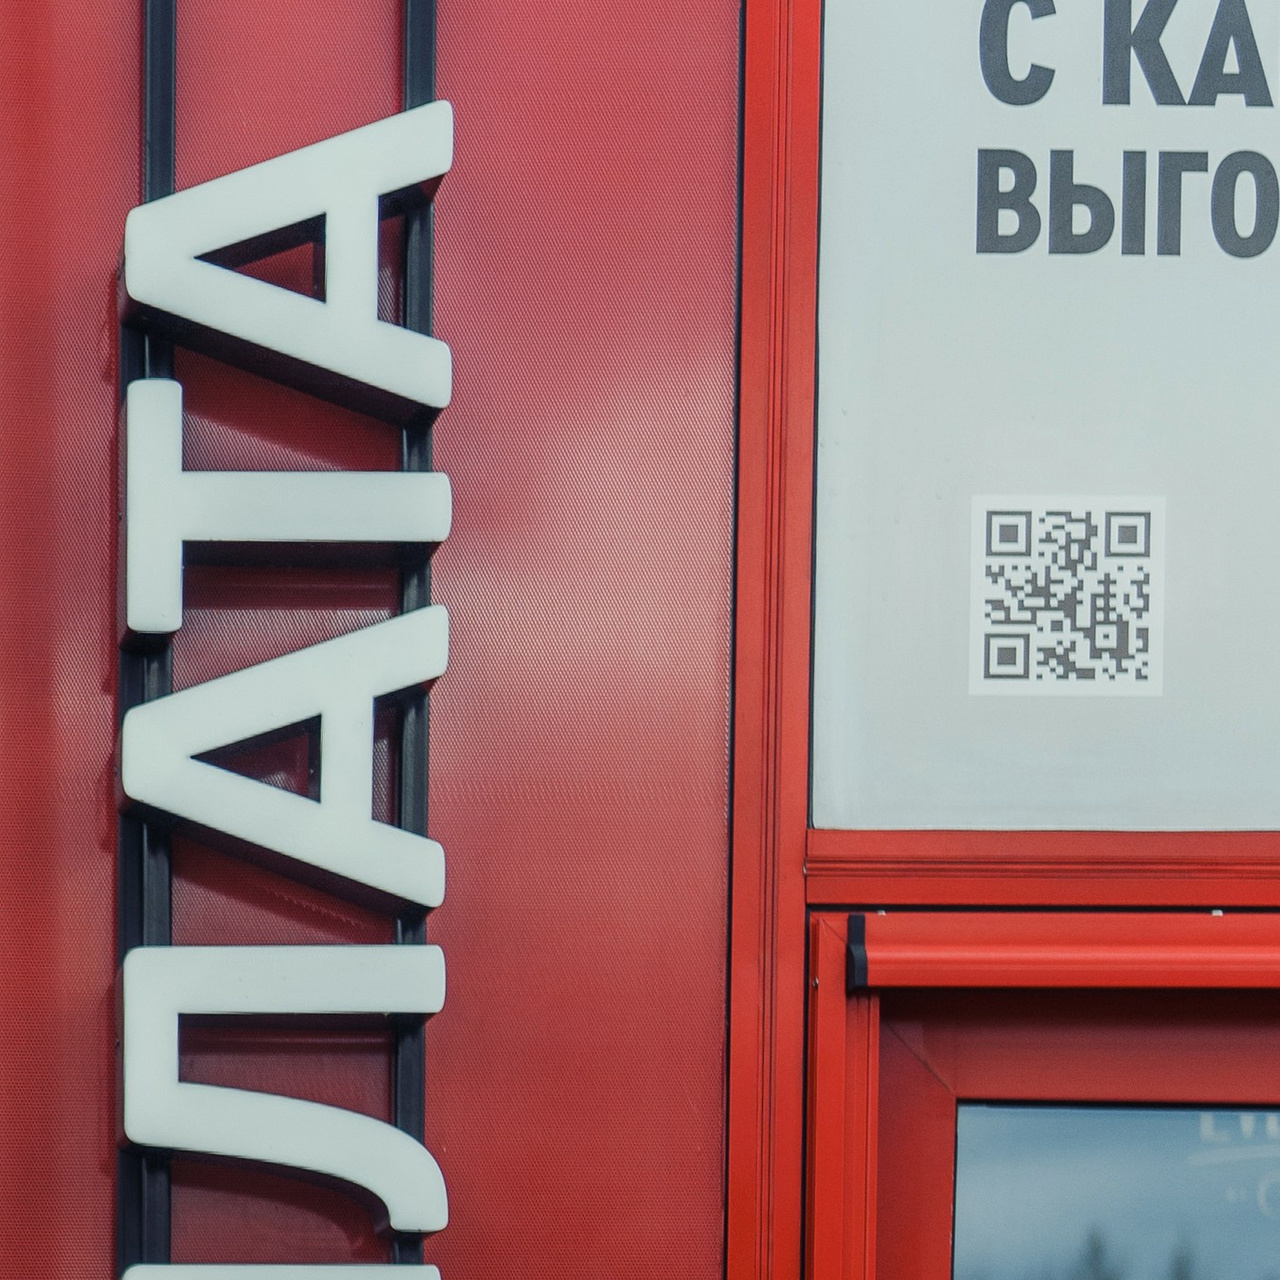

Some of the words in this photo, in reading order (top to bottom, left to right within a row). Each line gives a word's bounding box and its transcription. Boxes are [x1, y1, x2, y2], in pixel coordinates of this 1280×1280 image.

[978, 0, 1058, 106] С
[1102, 0, 1276, 107] КА
[975, 147, 1280, 259] ВЫГО
